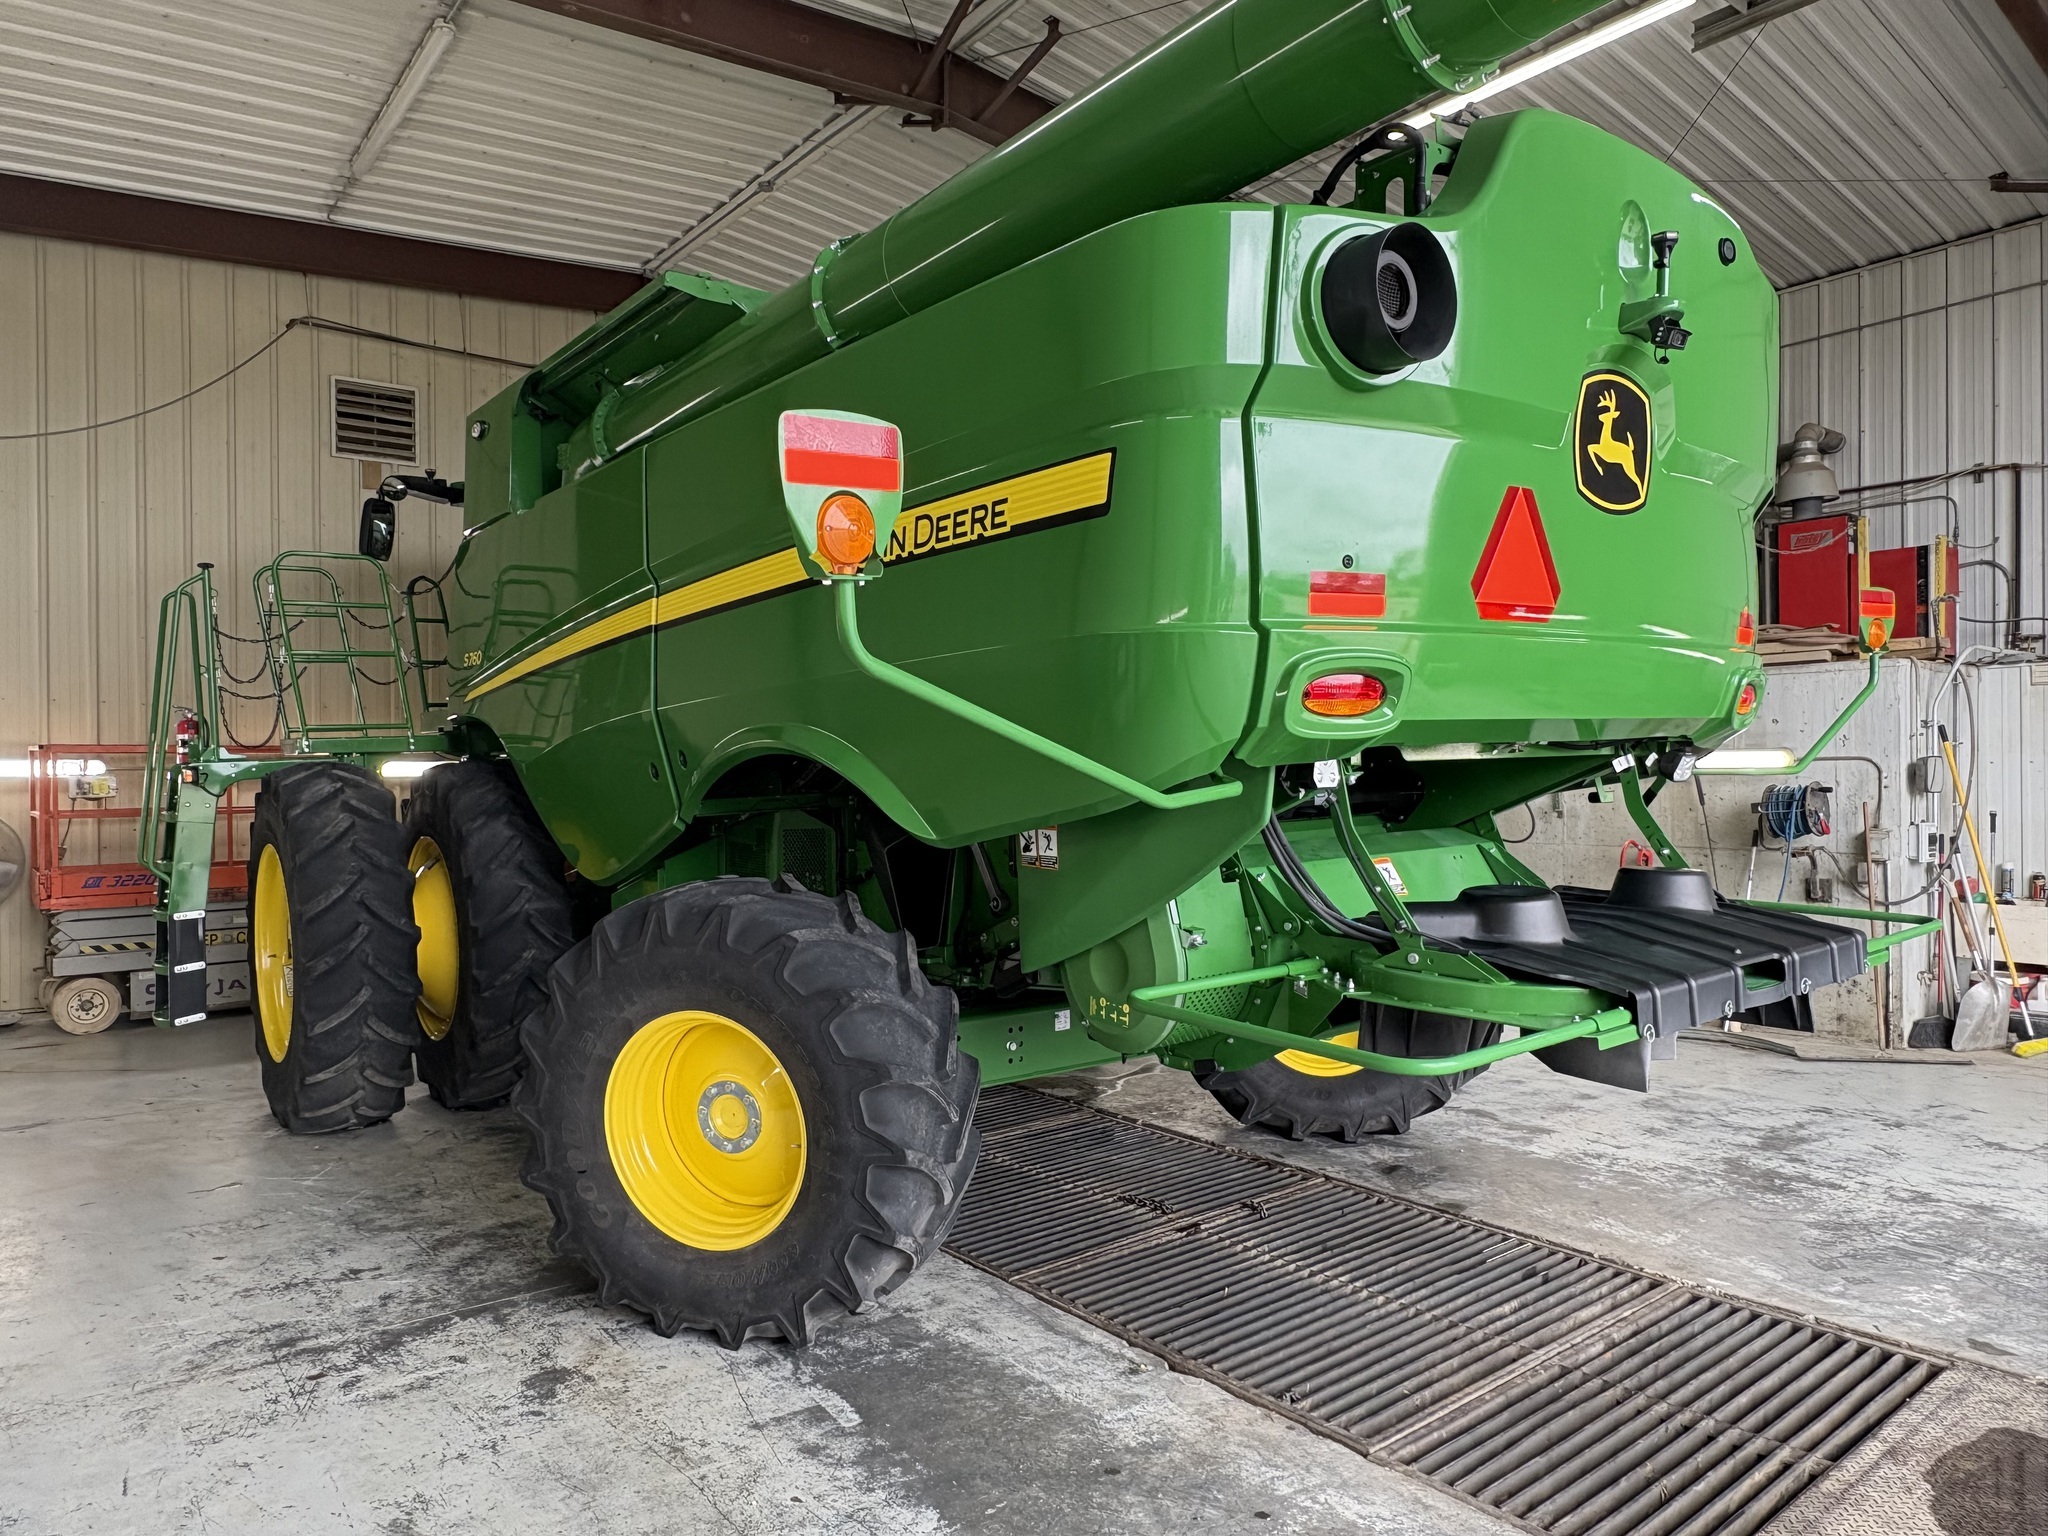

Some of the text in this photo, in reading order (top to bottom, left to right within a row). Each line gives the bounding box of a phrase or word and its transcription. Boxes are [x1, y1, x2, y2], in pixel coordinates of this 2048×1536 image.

[914, 497, 1009, 551] DEERE
[463, 650, 482, 667] S760
[107, 874, 157, 888] 3220
